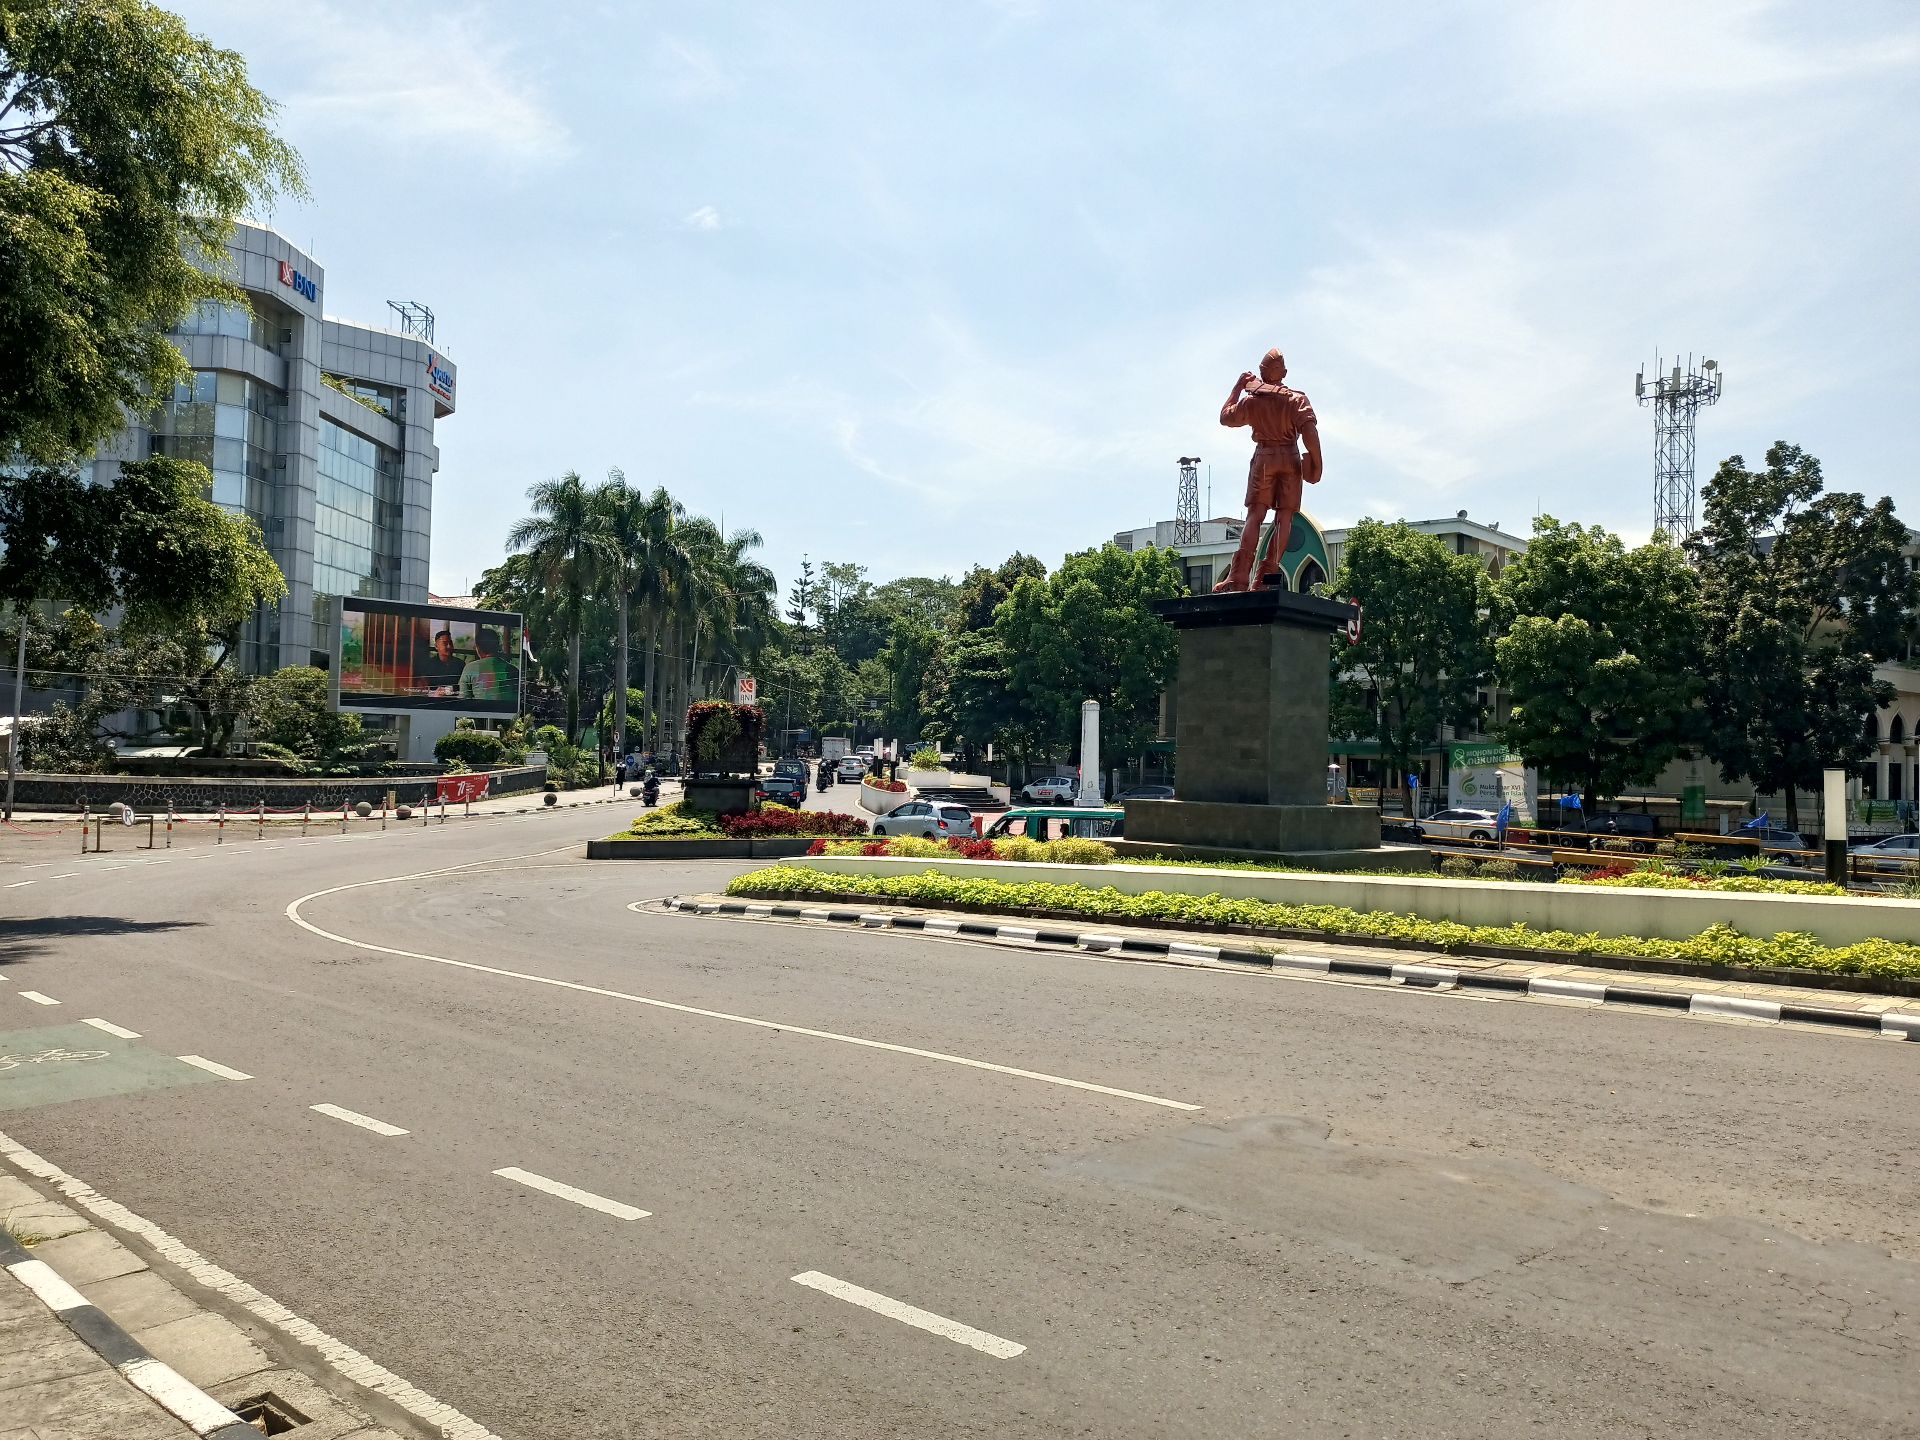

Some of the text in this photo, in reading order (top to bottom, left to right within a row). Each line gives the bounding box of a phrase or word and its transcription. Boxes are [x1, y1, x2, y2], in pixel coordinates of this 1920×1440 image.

[294, 270, 316, 302] BNI
[1466, 749, 1493, 757] MOHON
[1467, 754, 1524, 765] DUKUNGANN
